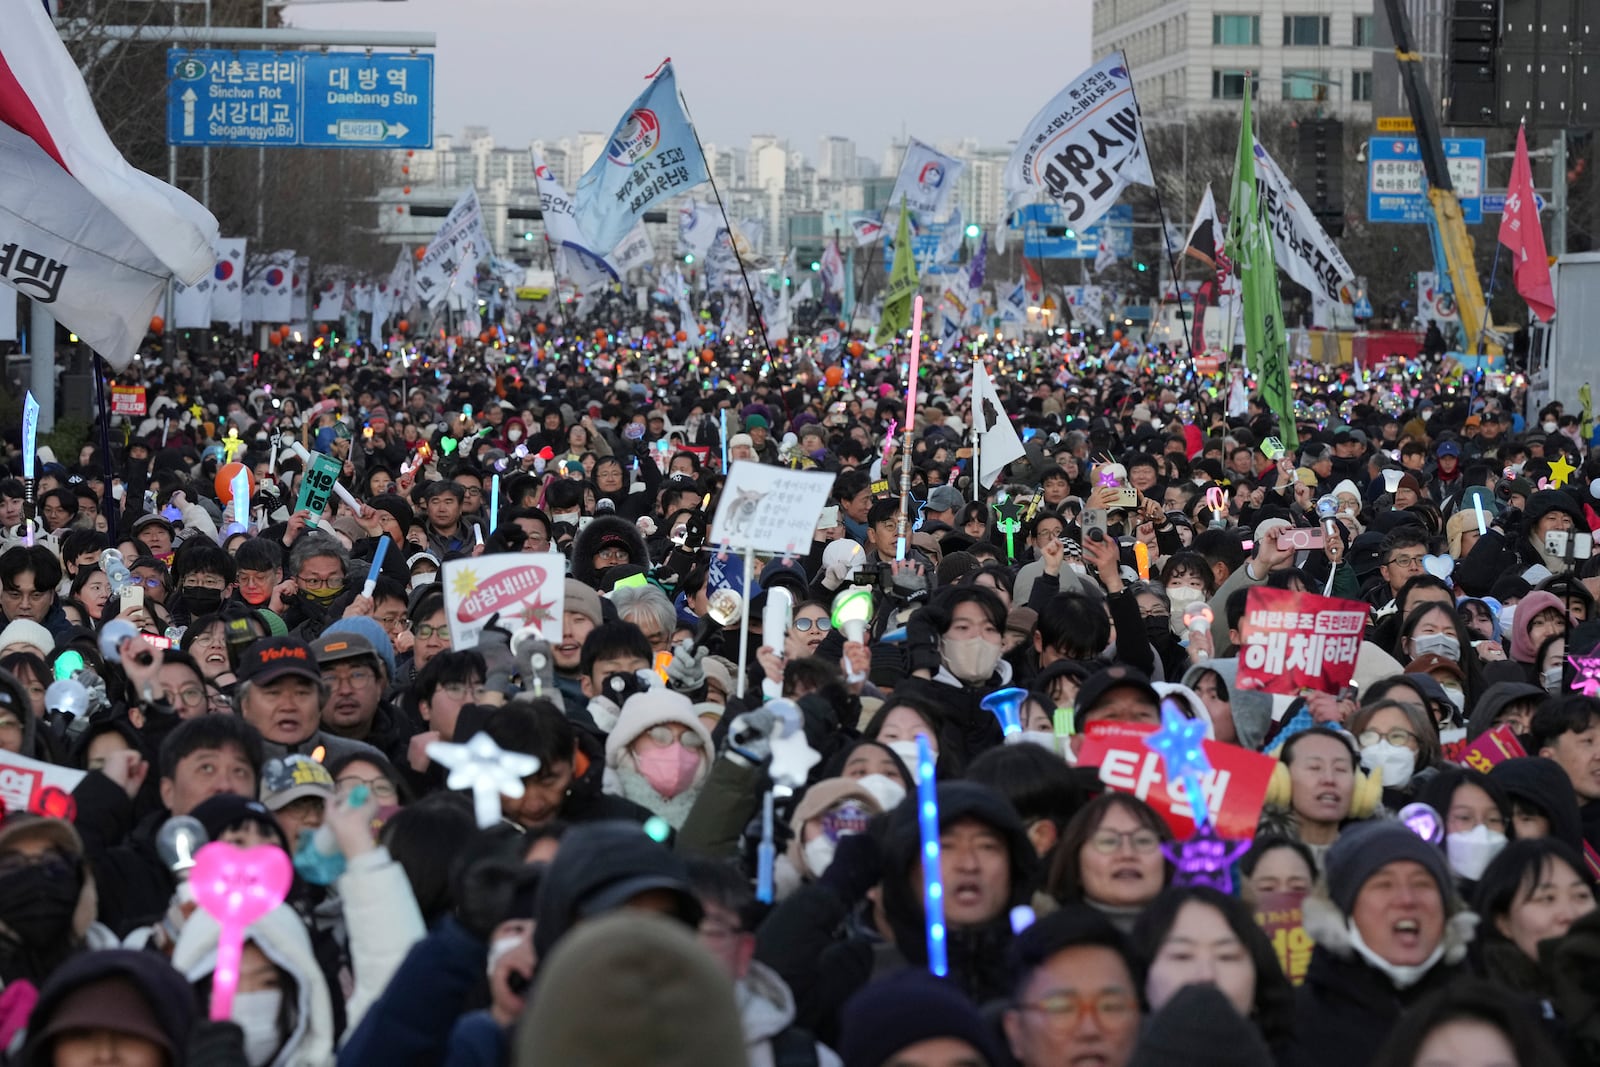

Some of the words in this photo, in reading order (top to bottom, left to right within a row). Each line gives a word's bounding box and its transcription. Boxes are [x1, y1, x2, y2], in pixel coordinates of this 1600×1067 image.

[185, 62, 195, 77] 6
[209, 61, 295, 84] 신촌로터리
[329, 67, 407, 91] 대방역
[209, 85, 254, 99] Sinchon
[259, 87, 282, 99] Rot
[327, 91, 390, 107] Daebang
[394, 93, 417, 104] Stn
[208, 102, 291, 124] 서강대교
[209, 124, 294, 141] Seoganggyo(Br)
[464, 568, 540, 615] 마참내!!!!
[1250, 610, 1314, 630] 내란동조
[1245, 632, 1358, 677] 해체하라
